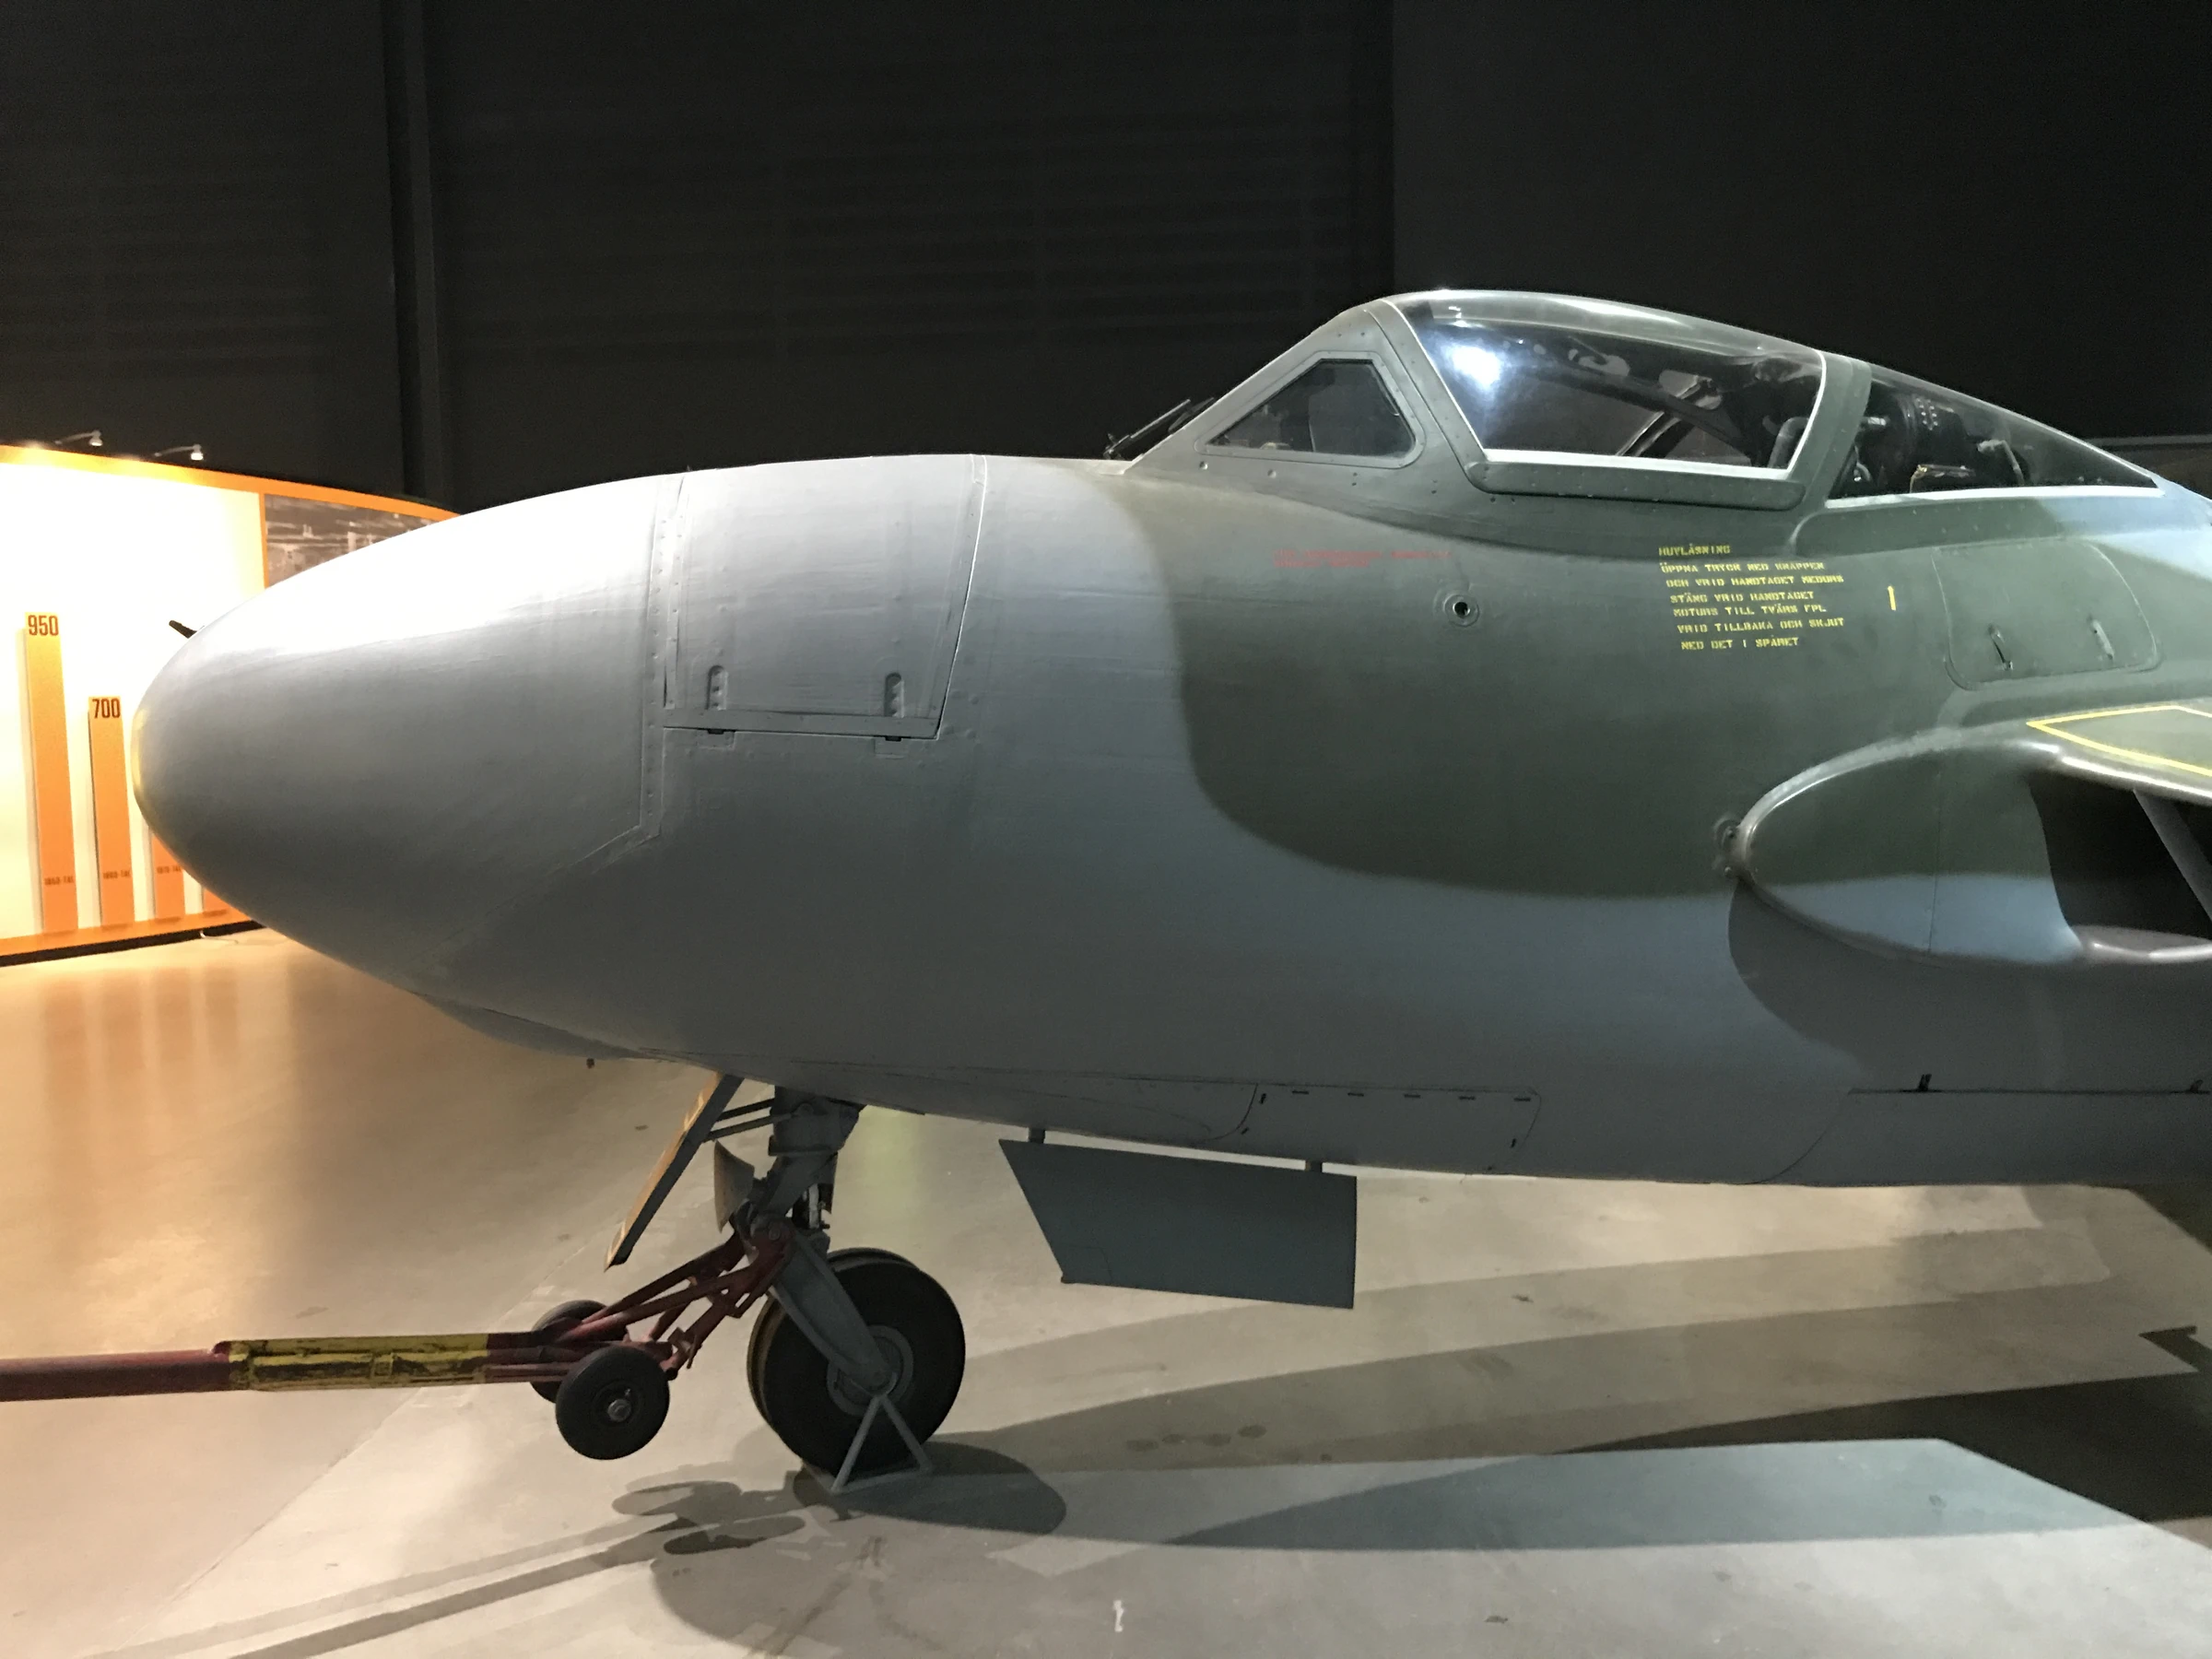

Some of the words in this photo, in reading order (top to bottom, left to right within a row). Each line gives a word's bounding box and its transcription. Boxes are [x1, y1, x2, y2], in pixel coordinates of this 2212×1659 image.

[1660, 562, 1698, 573] ÖPPNA
[1775, 562, 1825, 571] KNAPPEN
[1666, 579, 1688, 588] OCH
[1695, 578, 1724, 586] VRID
[1731, 576, 1794, 585] HANDTAGET
[1670, 593, 1708, 604] STÄNG
[1713, 594, 1744, 602] VRID
[1750, 591, 1814, 601] HANDTAGET
[1673, 607, 1718, 617] MOTURS
[1725, 606, 1755, 616] TILL
[1761, 603, 1797, 614] TVÄRS
[27, 615, 59, 637] 950
[1677, 624, 1708, 633] VRID
[1714, 621, 1773, 631] TILLBAKA
[1780, 620, 1803, 629] OCH
[1808, 618, 1843, 628] SKJUT
[1711, 640, 1733, 649] DET
[1755, 635, 1798, 647] SPÅRET
[92, 699, 121, 719] 700
